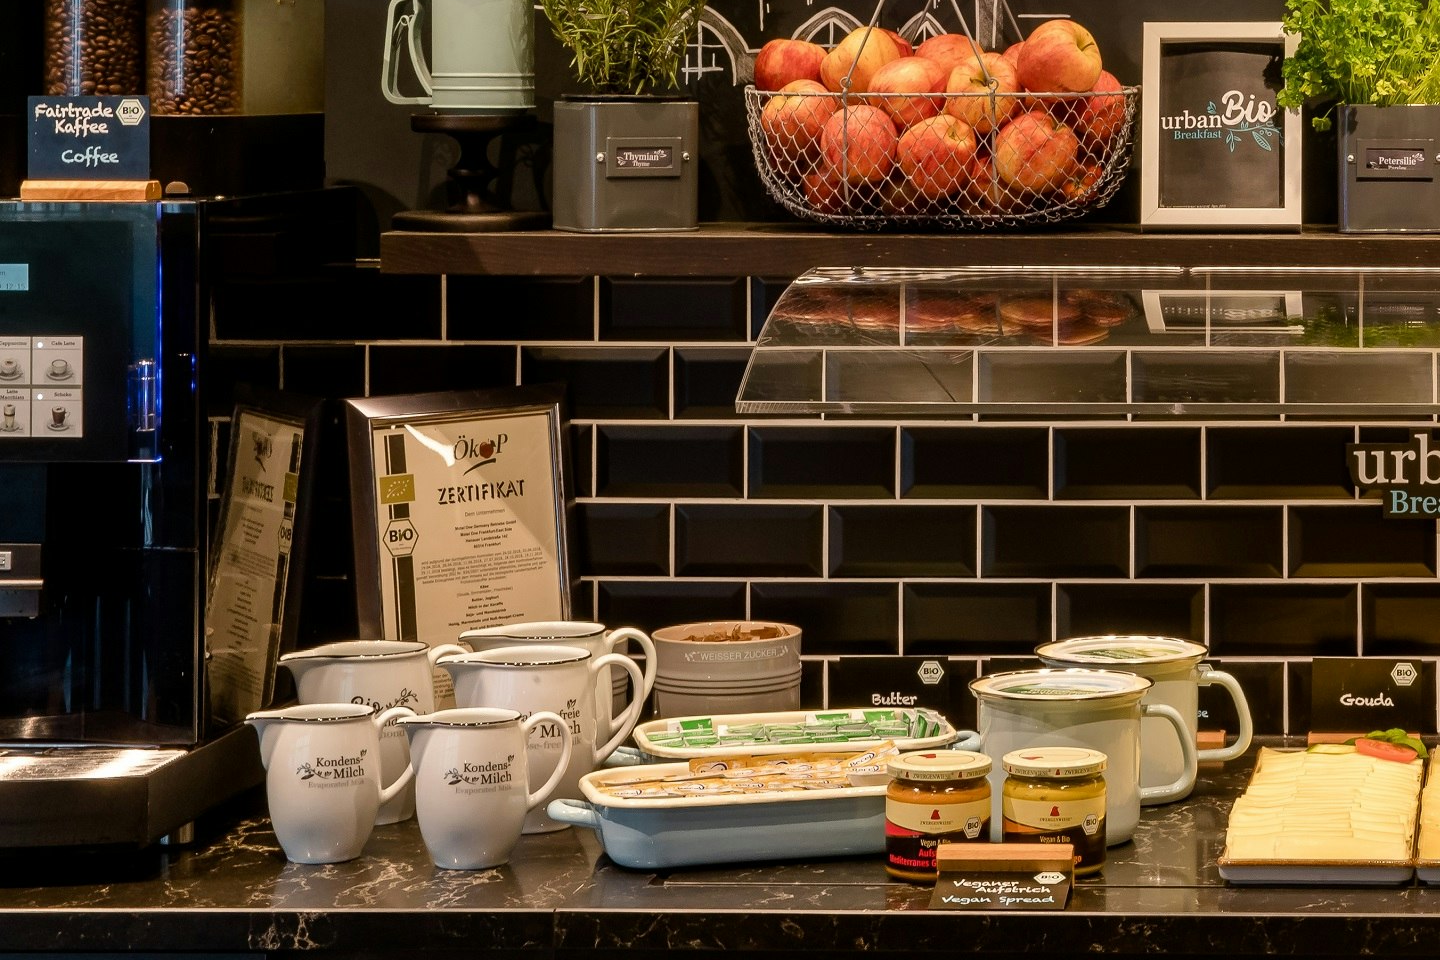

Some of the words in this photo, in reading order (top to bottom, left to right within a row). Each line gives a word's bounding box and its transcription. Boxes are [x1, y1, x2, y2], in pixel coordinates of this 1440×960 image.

[34, 101, 114, 121] Fairtrade
[1161, 109, 1223, 131] urban
[1221, 89, 1278, 126] Bio
[54, 116, 109, 138] Kaffee
[1173, 128, 1222, 141] Breakfast
[61, 146, 120, 167] Coffee
[623, 151, 660, 162] Thymian
[1378, 156, 1417, 166] Petersilie
[437, 478, 526, 506] ZERTIFIKAT
[700, 651, 742, 661] WEISSER
[743, 648, 777, 660] ZUCKER
[871, 692, 918, 707] Butter
[1339, 692, 1395, 708] Gouda
[316, 755, 363, 768] Kondens-
[463, 761, 511, 773] Kondens-
[333, 765, 365, 779] Milch
[480, 771, 512, 785] Milch
[920, 839, 937, 848] Vegan
[1039, 836, 1056, 844] Vegan
[953, 879, 1020, 889] Veganer
[975, 886, 1051, 895] Aufstrich
[941, 895, 992, 905] Vegan
[998, 895, 1055, 906] Spread
